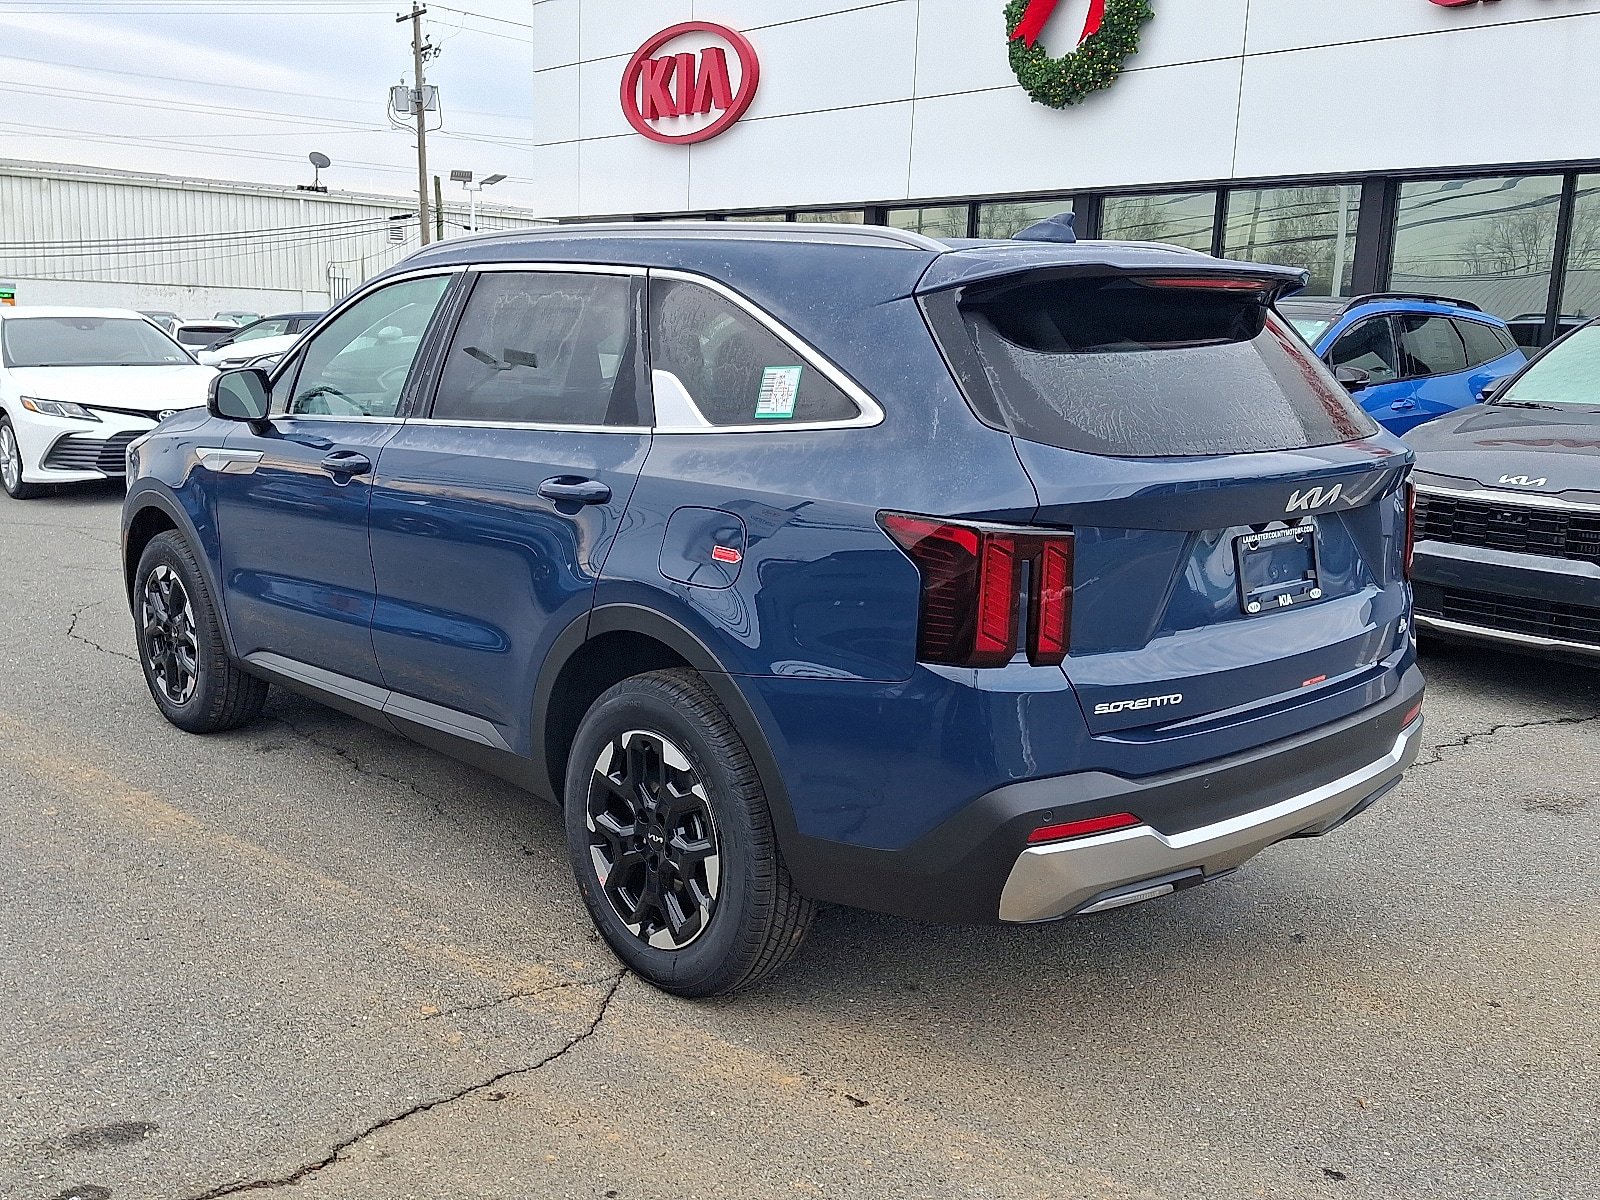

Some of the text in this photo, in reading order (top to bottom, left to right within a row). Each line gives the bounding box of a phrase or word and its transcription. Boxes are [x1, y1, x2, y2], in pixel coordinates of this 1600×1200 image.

[641, 47, 733, 120] KIA
[1498, 474, 1547, 487] KIA
[1285, 483, 1342, 512] KIA
[1278, 594, 1293, 606] KIA
[1093, 693, 1183, 715] SORENTO
